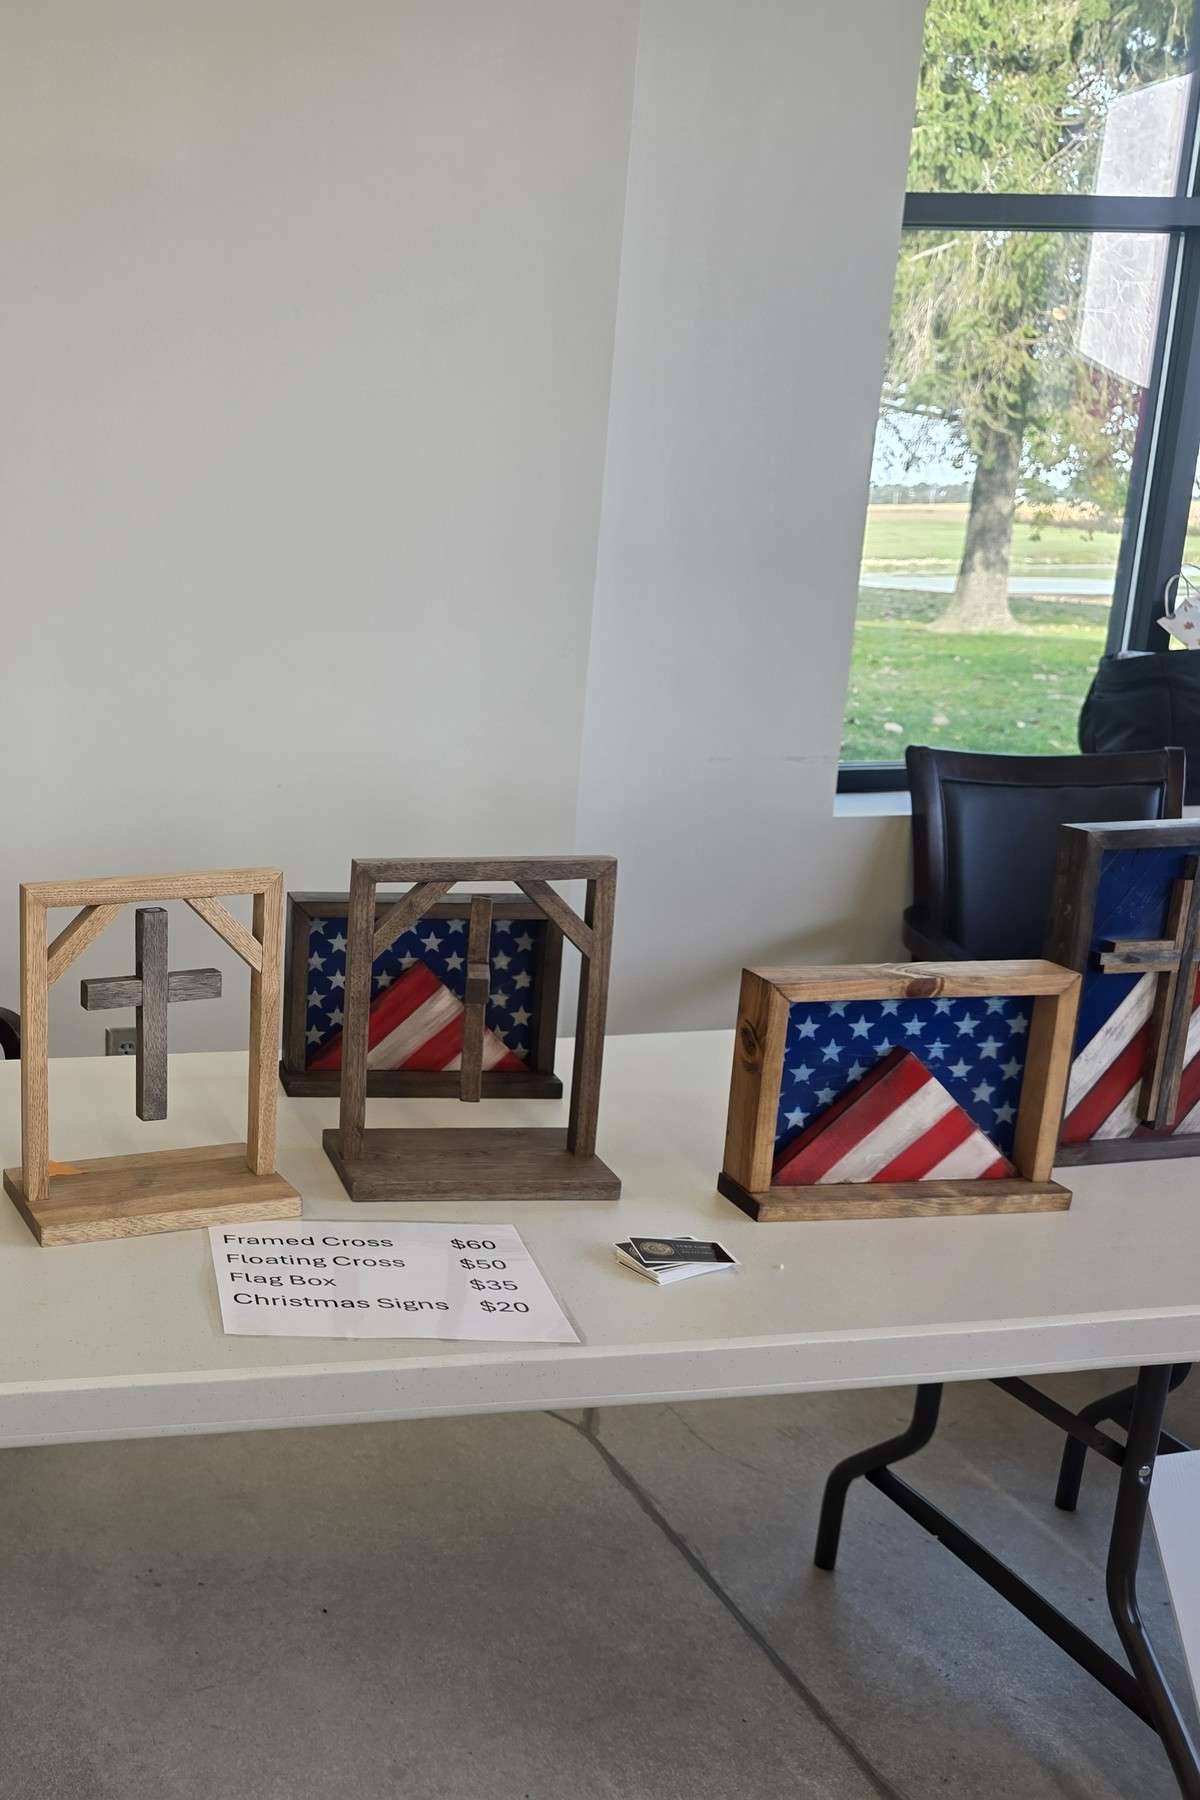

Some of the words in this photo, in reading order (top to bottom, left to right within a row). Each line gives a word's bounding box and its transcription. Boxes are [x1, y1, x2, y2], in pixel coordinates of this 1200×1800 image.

[223, 1234, 315, 1246] Framed
[321, 1236, 394, 1248] Cross
[450, 1237, 497, 1251] $60
[226, 1253, 328, 1269] Floating
[332, 1255, 406, 1268] Cross
[459, 1257, 507, 1271] $50
[229, 1271, 284, 1287] Flag
[289, 1274, 337, 1287] Box
[469, 1278, 519, 1292] $35
[233, 1292, 371, 1309] Christmas
[376, 1297, 450, 1312] Signs
[479, 1299, 530, 1313] $20
